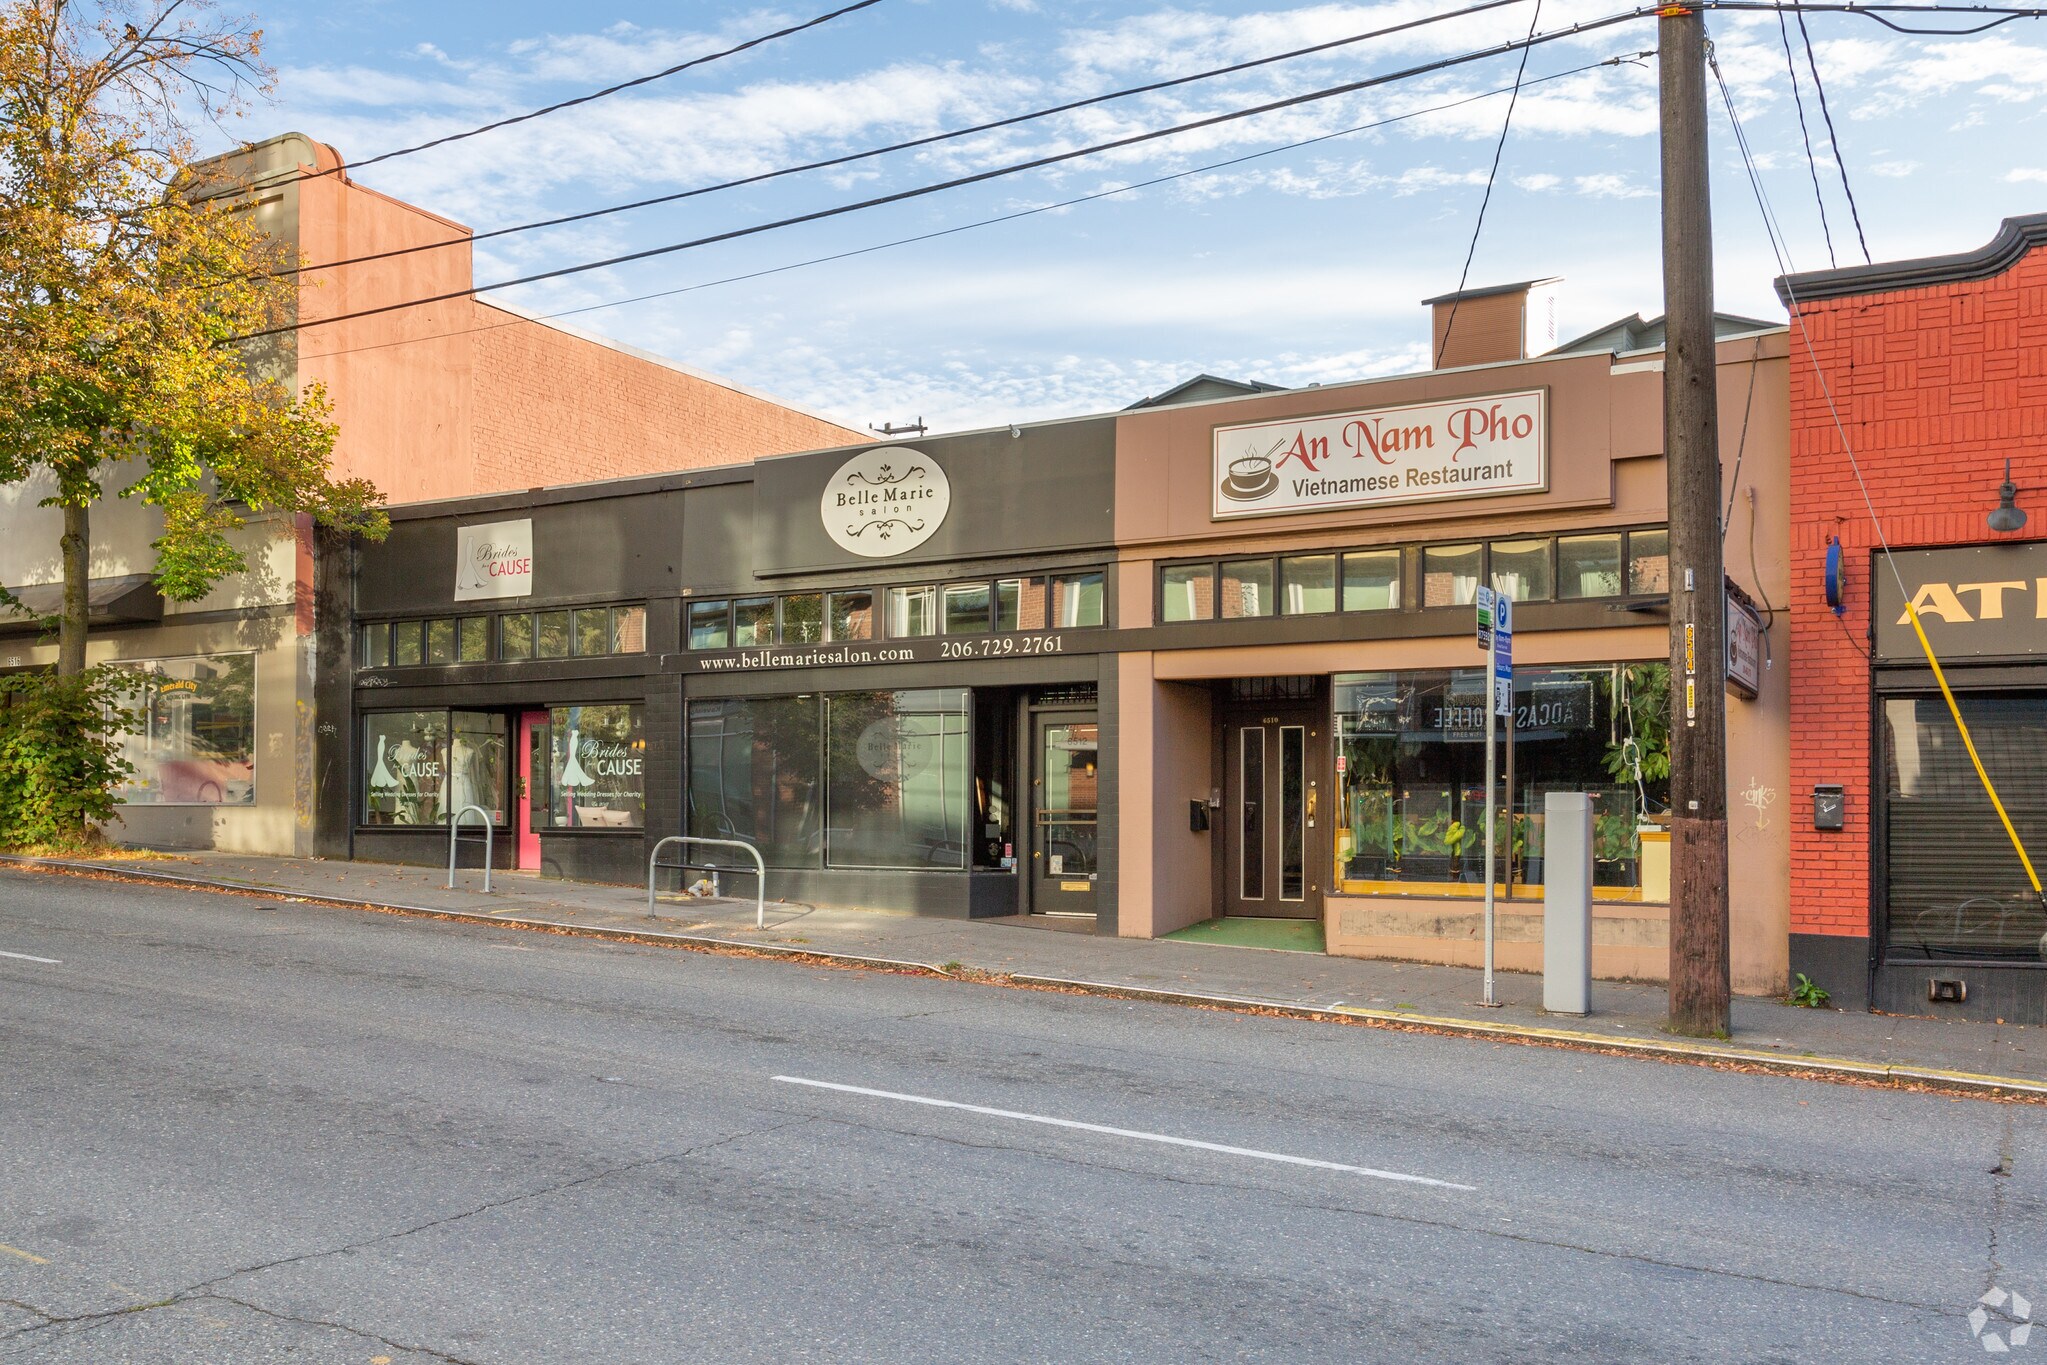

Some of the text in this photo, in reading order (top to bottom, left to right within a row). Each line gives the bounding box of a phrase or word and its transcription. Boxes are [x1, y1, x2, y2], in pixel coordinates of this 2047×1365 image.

[1276, 404, 1533, 472] An Nam Pho
[1292, 459, 1514, 498] Vietnamese Restaurant
[836, 485, 934, 507] Belle Marie
[859, 505, 912, 516] salon
[476, 542, 519, 562] Brides
[489, 558, 531, 577] CAUSE
[1895, 577, 2047, 625] AT
[700, 635, 1063, 669] www.bellemariesalon.com 206.729.2761
[1686, 627, 1694, 670] 6504
[185, 681, 198, 693] City
[1262, 716, 1279, 724] 6510
[581, 739, 628, 759] Brides
[1067, 737, 1088, 746] 6512
[401, 761, 440, 778] CAUSE
[597, 759, 642, 776] CAUSE
[576, 791, 596, 799] Wedding
[623, 791, 642, 799] Charity
